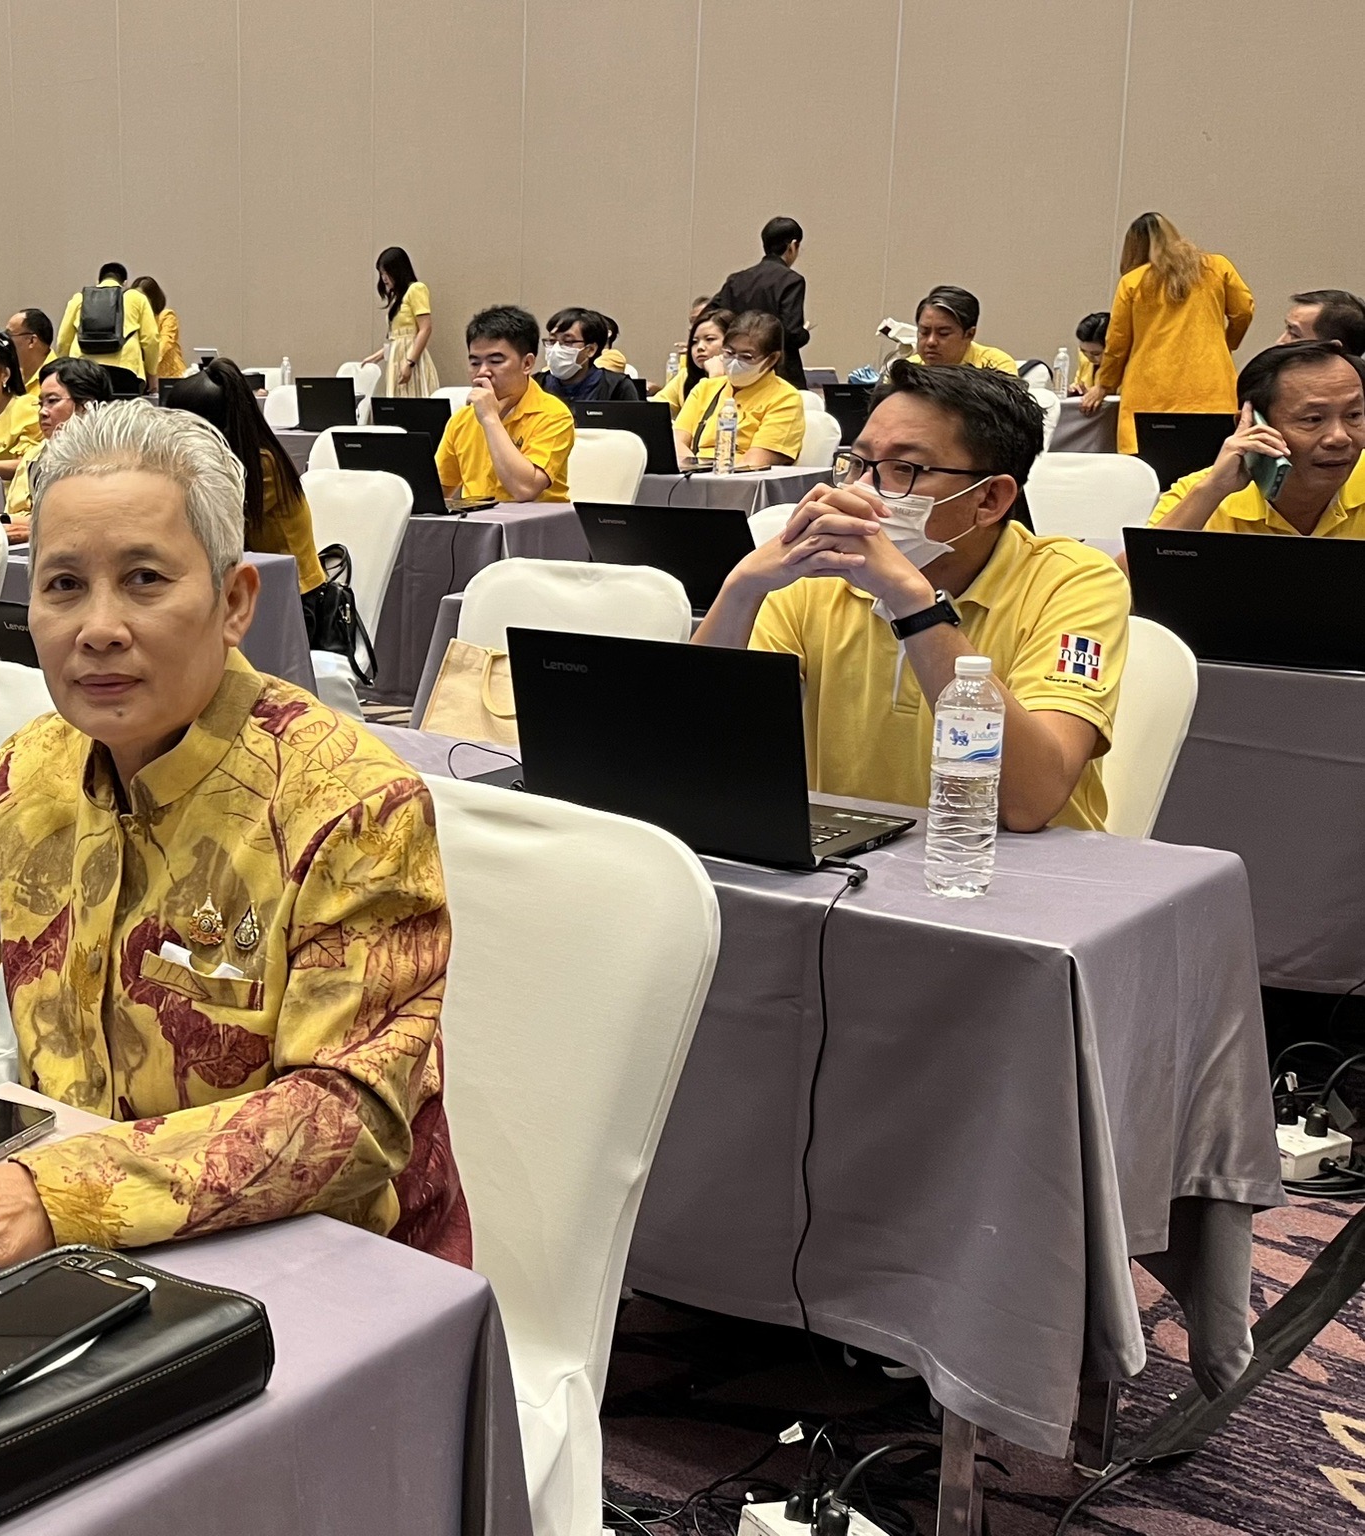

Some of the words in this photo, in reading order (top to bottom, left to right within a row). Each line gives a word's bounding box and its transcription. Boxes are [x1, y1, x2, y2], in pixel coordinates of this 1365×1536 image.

[1156, 547, 1198, 557] Lenovo
[3, 621, 29, 632] Lenov
[542, 658, 588, 673] Lenovo
